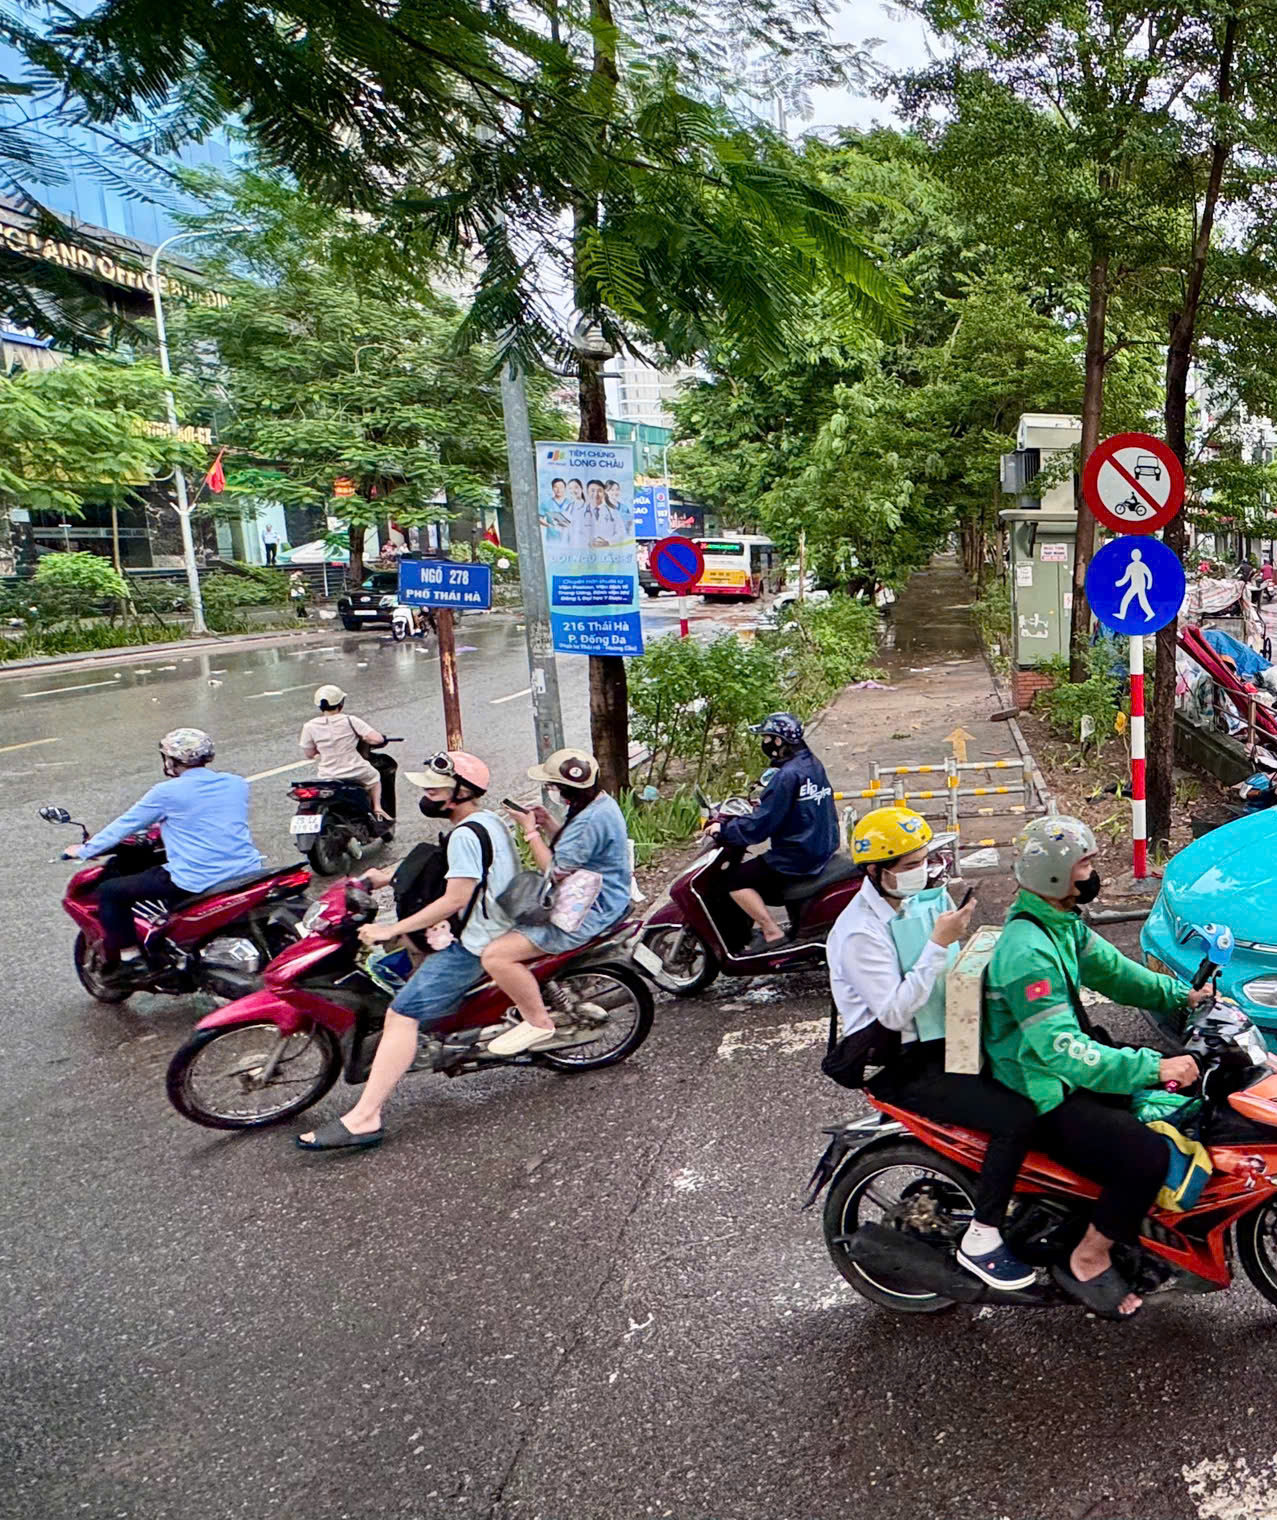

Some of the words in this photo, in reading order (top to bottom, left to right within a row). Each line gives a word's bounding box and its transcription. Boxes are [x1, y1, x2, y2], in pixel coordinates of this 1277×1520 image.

[569, 460, 597, 468] LONG
[598, 460, 625, 469] CHÂU
[420, 566, 443, 584] NGÕ
[449, 569, 470, 586] 278
[406, 587, 432, 600] PHỐ
[433, 589, 462, 602] THÁI
[463, 590, 482, 603] HÀ
[562, 622, 585, 632] 216
[588, 621, 612, 632] Thái
[614, 621, 630, 632] Hà
[568, 635, 578, 644] P.
[580, 634, 609, 646] Đống
[611, 635, 627, 645] Đa
